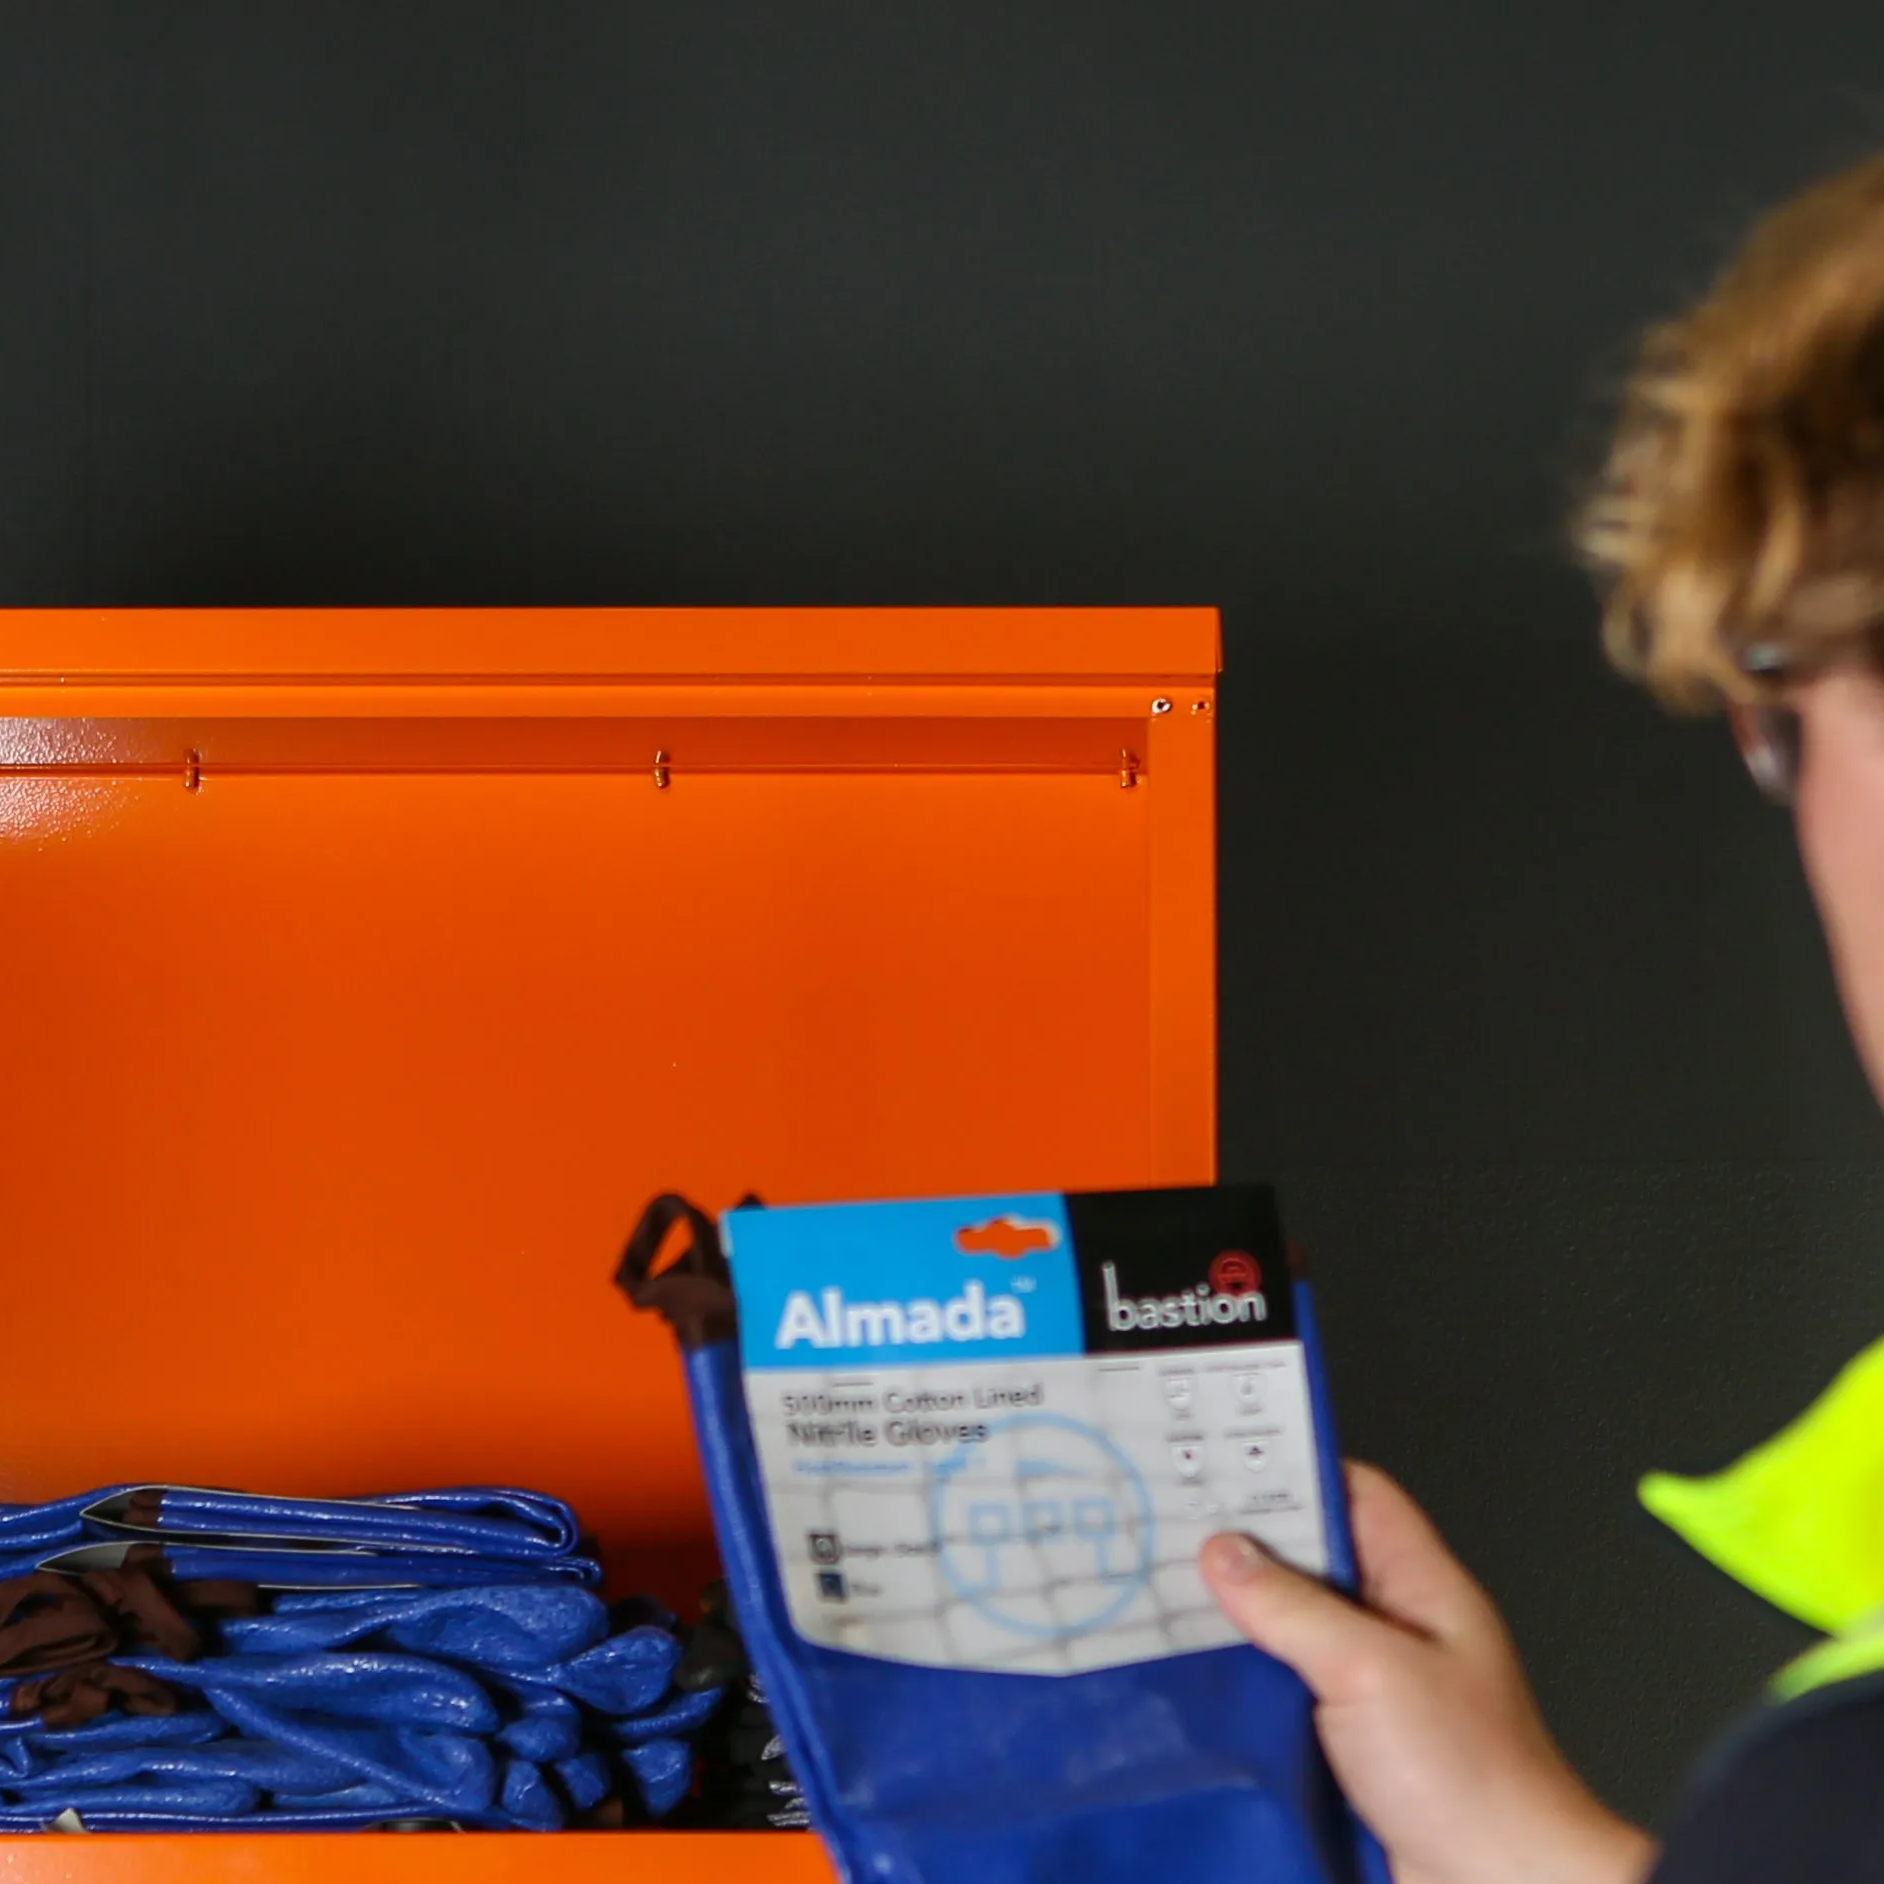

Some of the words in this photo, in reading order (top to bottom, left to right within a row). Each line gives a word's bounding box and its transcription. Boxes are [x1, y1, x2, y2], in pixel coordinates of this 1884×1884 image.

[774, 1278, 1026, 1349] Almada
[1103, 1261, 1268, 1331] bastion
[884, 1391, 965, 1413] Cotton
[973, 1383, 1044, 1409] Lined
[883, 1419, 989, 1446] Gloves
